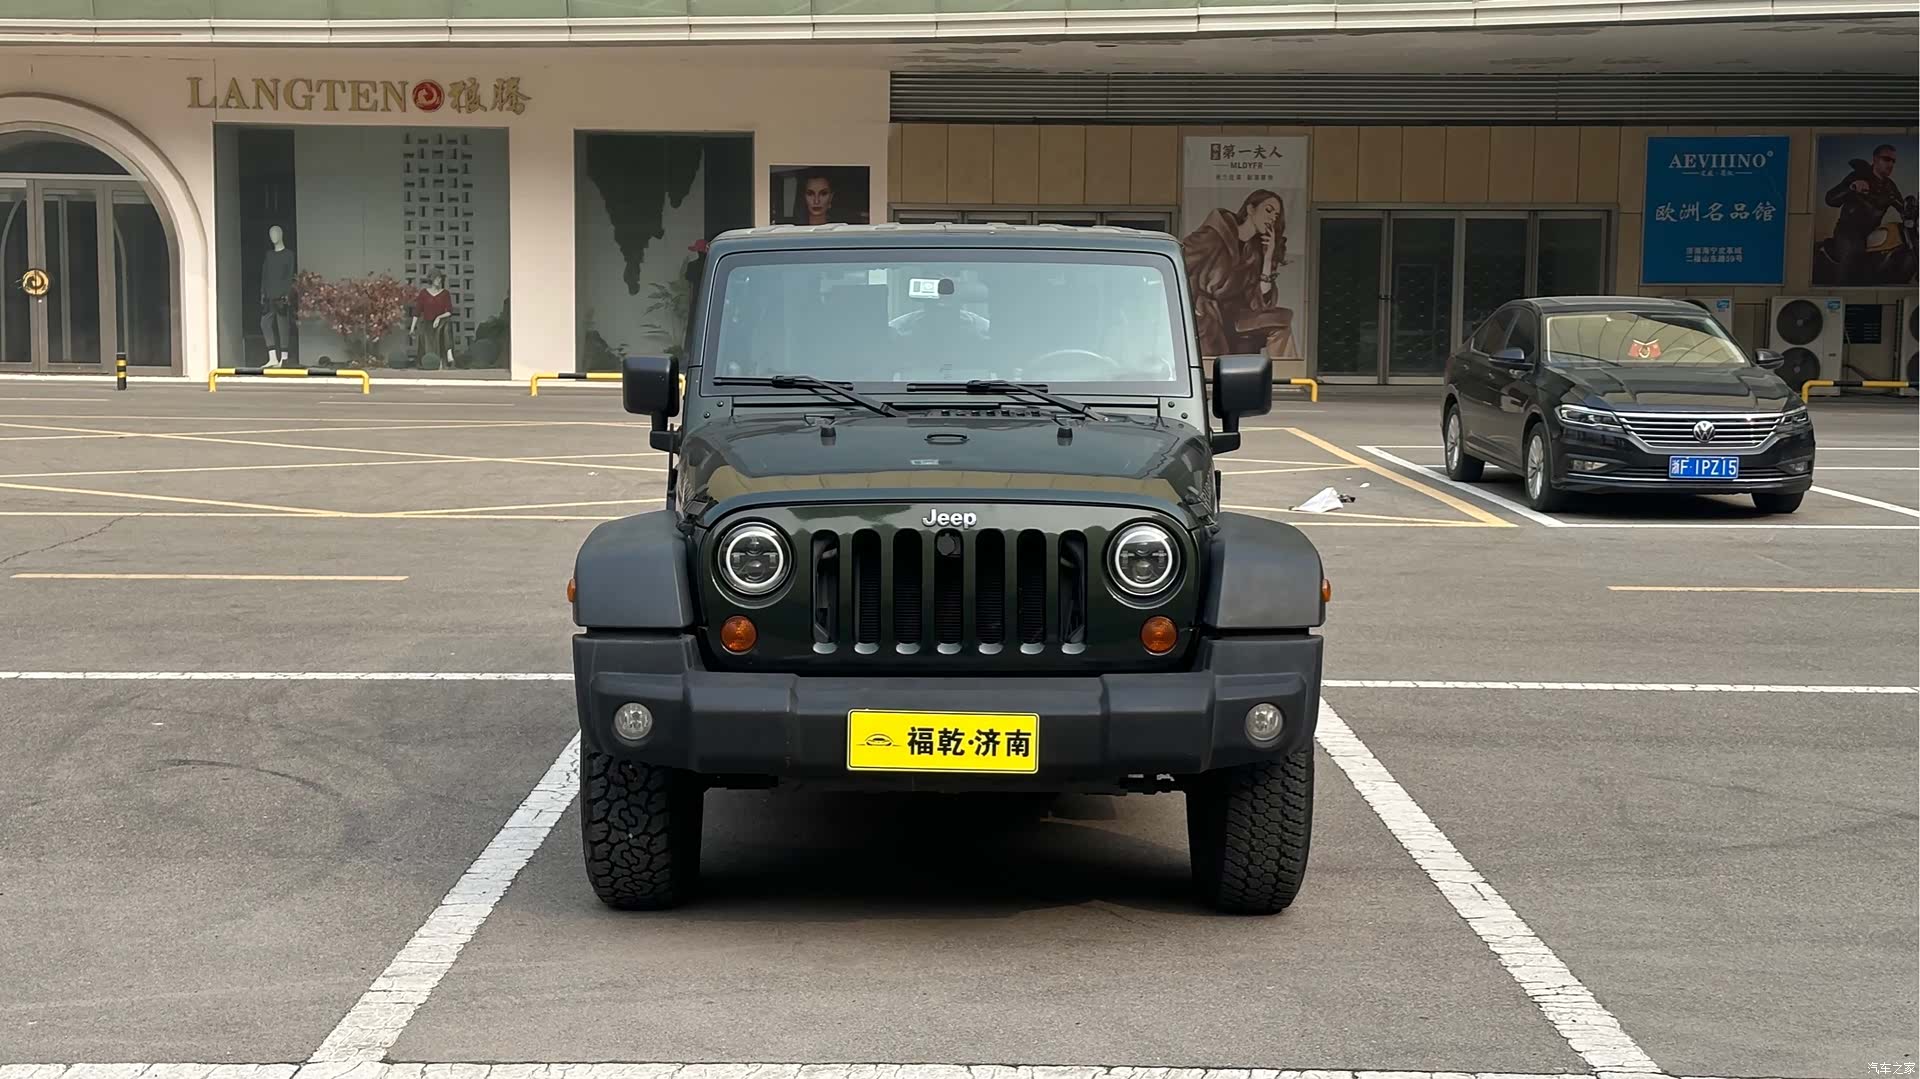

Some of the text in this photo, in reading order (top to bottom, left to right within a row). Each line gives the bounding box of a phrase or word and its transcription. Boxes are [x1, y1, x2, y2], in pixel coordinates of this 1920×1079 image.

[186, 76, 410, 113] LANGTEN
[1655, 200, 1777, 222] 欧洲名品馆
[922, 508, 977, 530] Jeep
